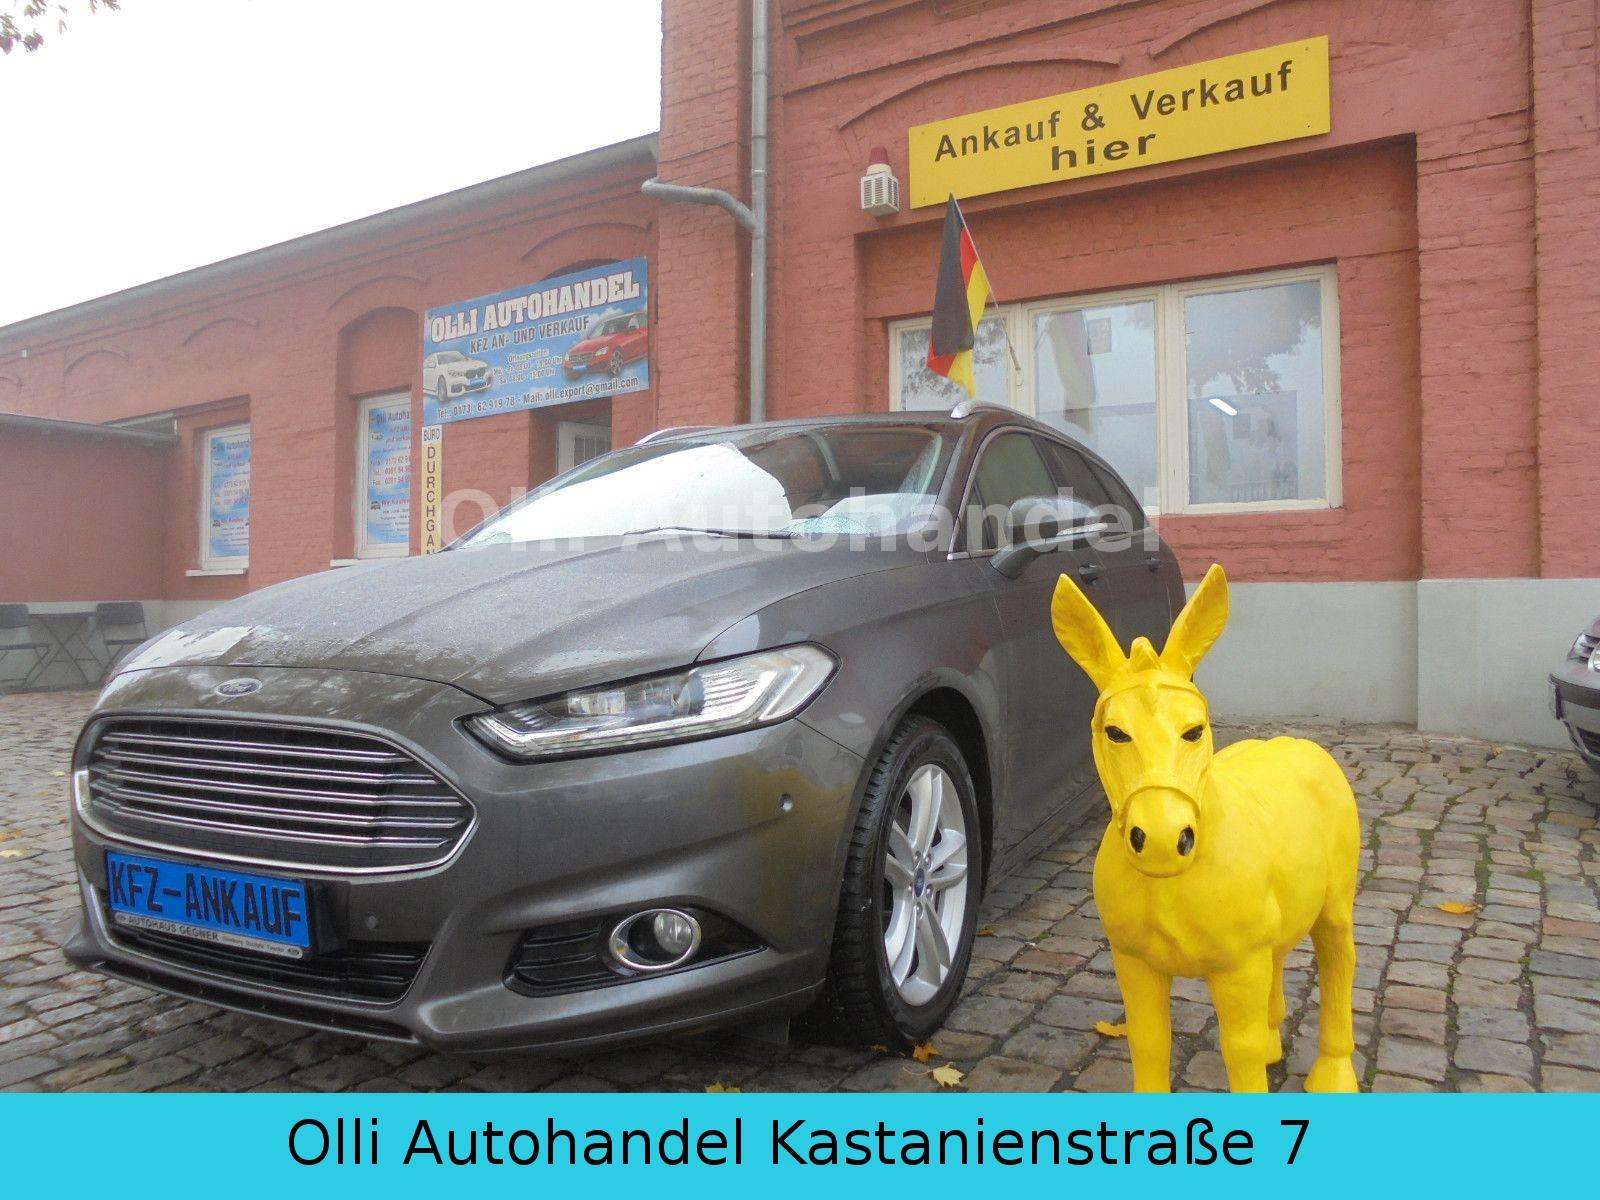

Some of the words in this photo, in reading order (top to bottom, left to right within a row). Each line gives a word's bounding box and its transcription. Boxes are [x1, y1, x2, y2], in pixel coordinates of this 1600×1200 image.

[934, 110, 1061, 163] Ankauf
[1081, 103, 1105, 131] &
[1129, 60, 1292, 120] Verkauf
[1051, 133, 1156, 171] hier
[431, 309, 478, 343] OLLI
[484, 271, 640, 331] AUTOHANDEL
[470, 337, 488, 354] KFZ
[491, 334, 509, 349] AN-
[513, 329, 535, 345] UND
[540, 316, 590, 339] VERKAUF
[477, 401, 487, 412] 62
[488, 398, 503, 410] 919
[505, 396, 515, 407] 78
[523, 392, 543, 405] Mail:
[545, 377, 638, 400] olli.export@gmail.com
[423, 428, 440, 442] BÜRO
[110, 860, 301, 937] KFZ-ANKAUF
[127, 915, 177, 933] AUTOHAUS
[179, 925, 219, 941] GEGNER
